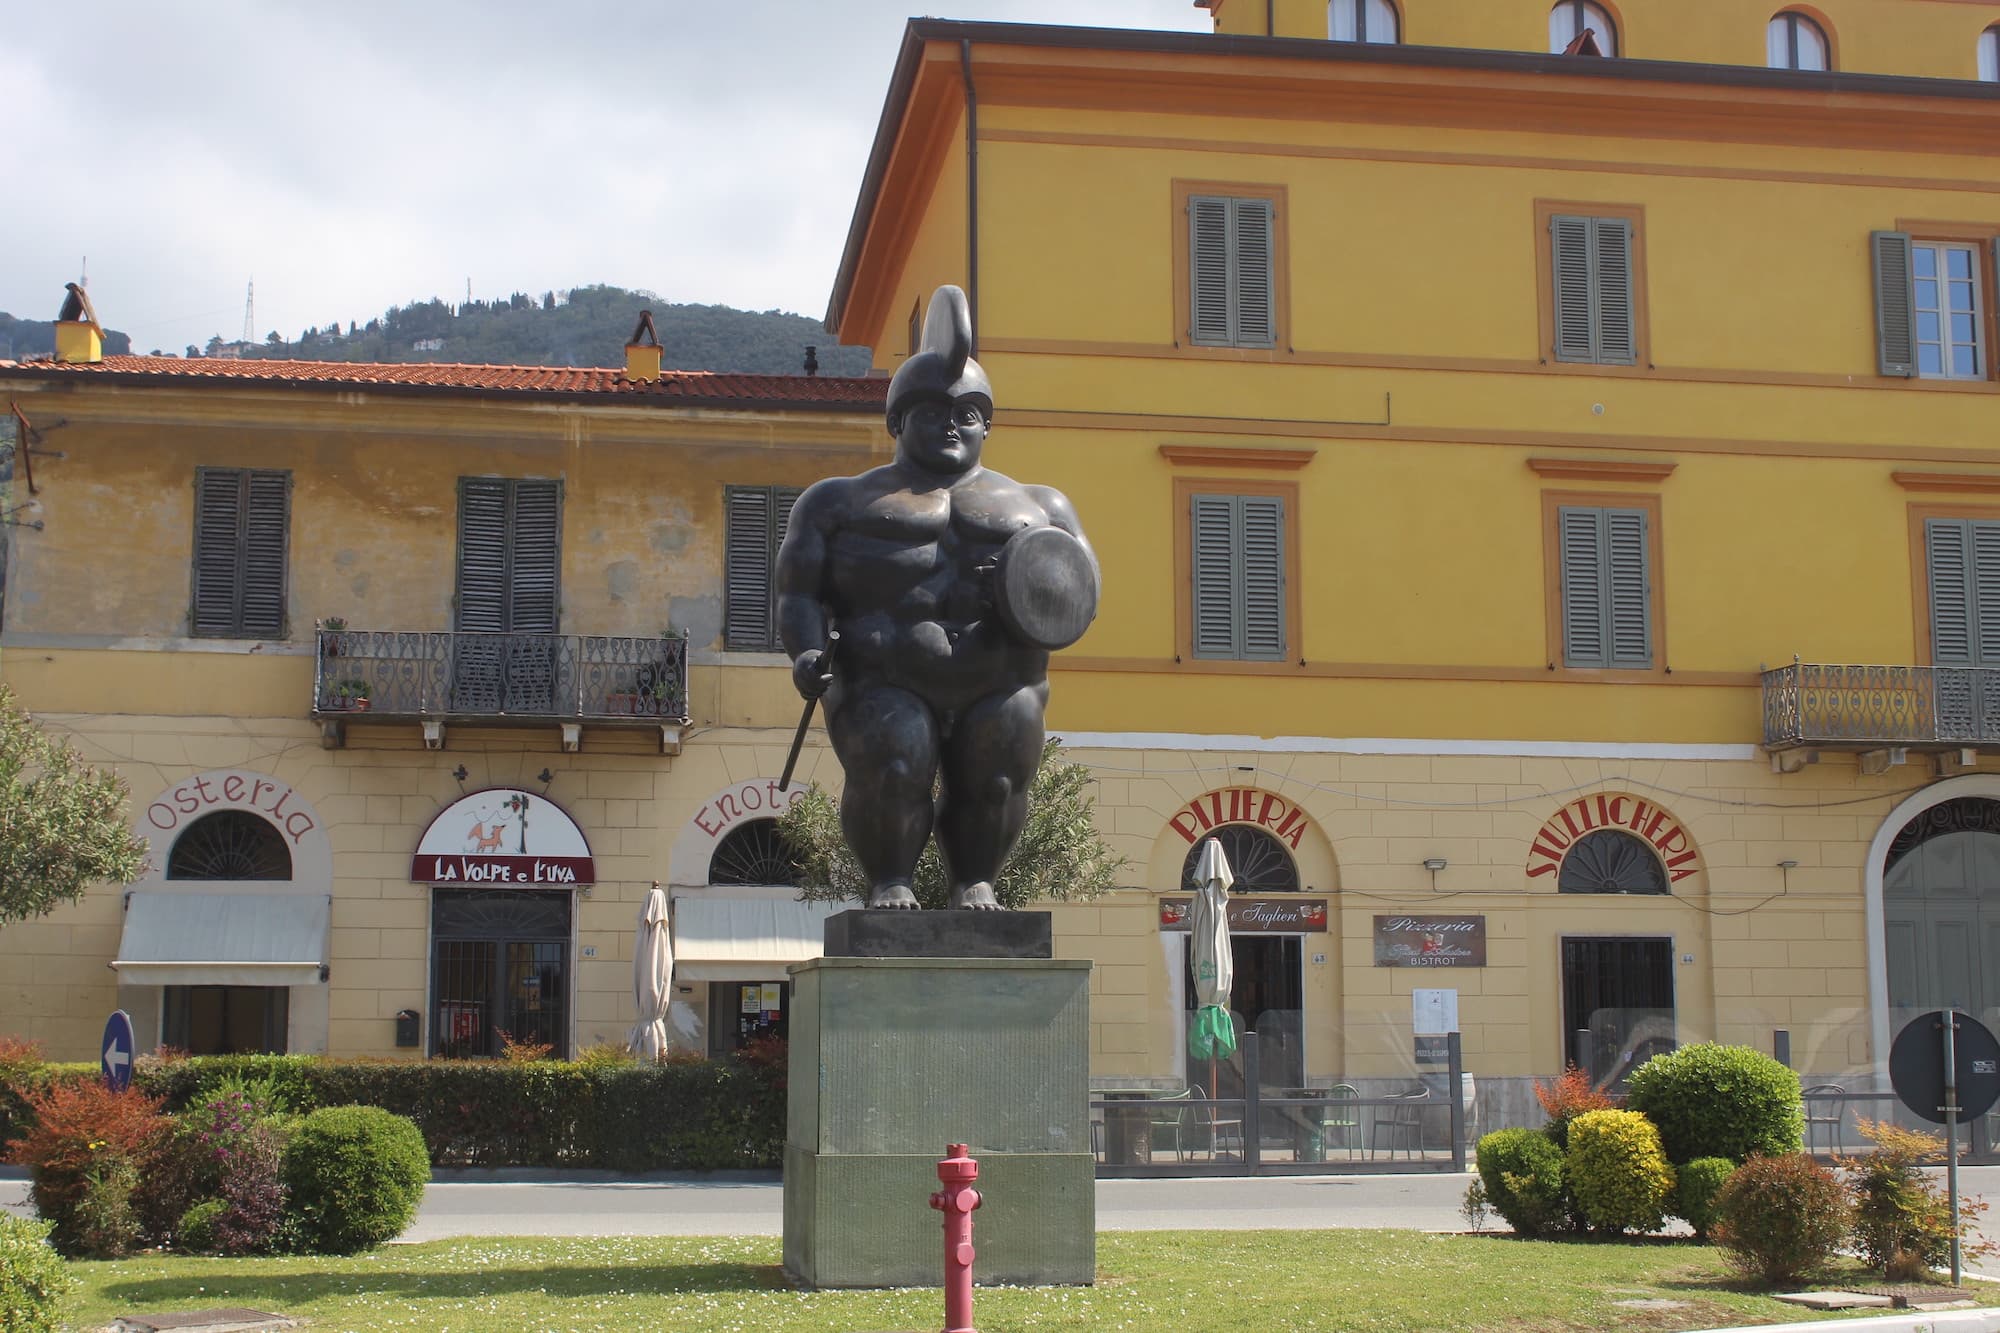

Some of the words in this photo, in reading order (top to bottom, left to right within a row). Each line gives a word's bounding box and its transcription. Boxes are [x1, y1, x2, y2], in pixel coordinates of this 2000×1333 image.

[148, 775, 315, 845] Osteria
[1169, 789, 1309, 850] PIZZERIA
[1525, 795, 1700, 883] STUZZICHERIA
[434, 856, 457, 881] LA
[461, 856, 511, 882] VOLPE
[516, 870, 528, 882] e
[533, 857, 576, 883] L'UVA
[1241, 901, 1299, 929] Taglieri
[1382, 917, 1476, 932] Pizzeria
[1410, 956, 1457, 966] BISTROT
